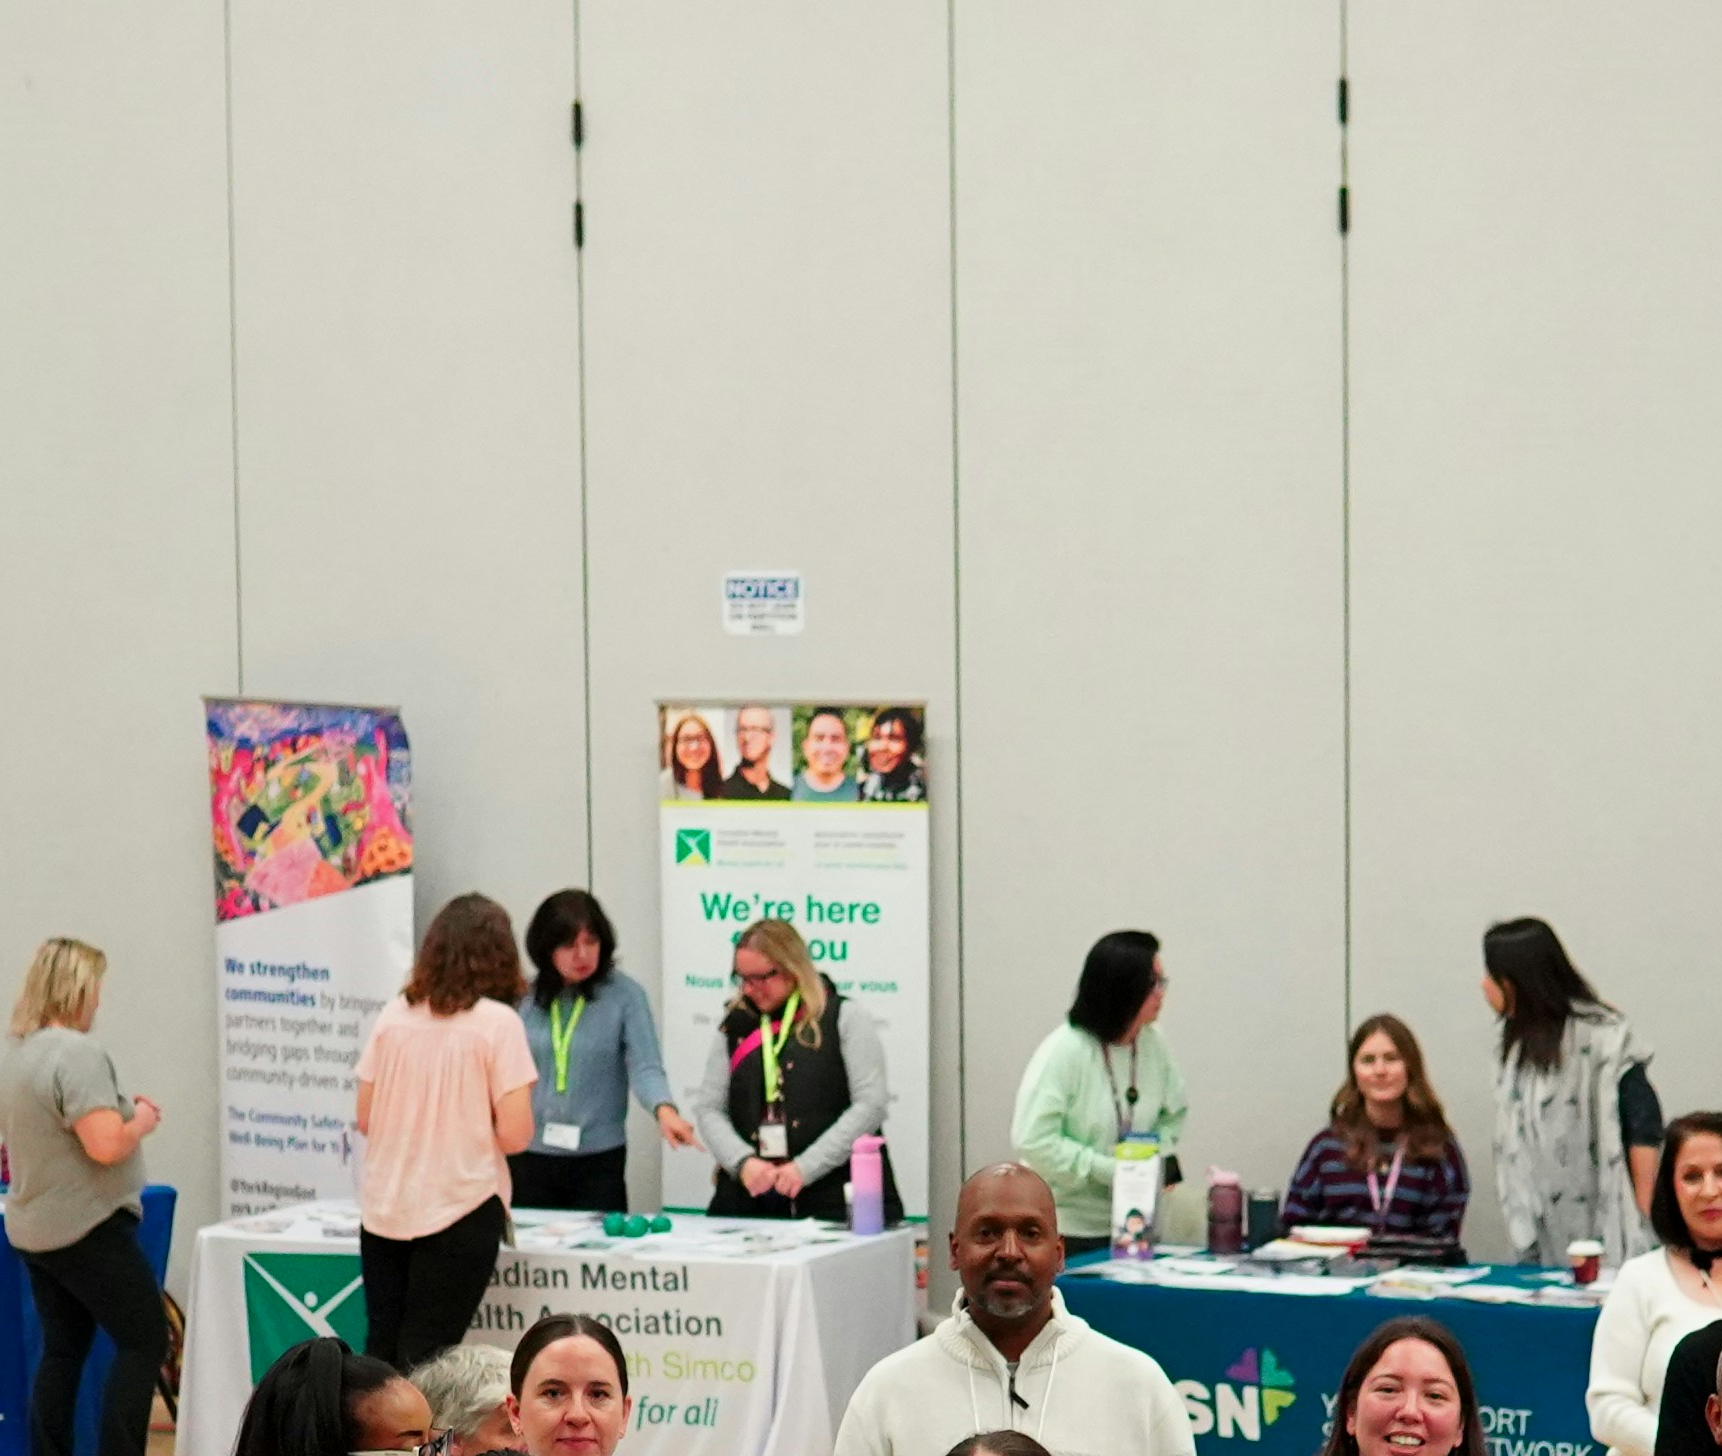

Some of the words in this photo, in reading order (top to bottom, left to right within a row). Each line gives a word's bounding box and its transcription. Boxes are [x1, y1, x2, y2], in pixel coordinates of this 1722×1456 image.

[700, 892, 795, 923] We're
[805, 894, 881, 924] here
[807, 939, 849, 961] ou
[224, 957, 245, 975] We
[249, 960, 331, 983] strengthen
[224, 987, 317, 1008] communities
[486, 1261, 569, 1290] adian
[580, 1262, 689, 1292] Mental
[469, 1304, 525, 1331] alth
[635, 1395, 677, 1432] for
[683, 1396, 720, 1427] all
[1174, 1378, 1262, 1442] SN
[1479, 1405, 1533, 1437] ORT
